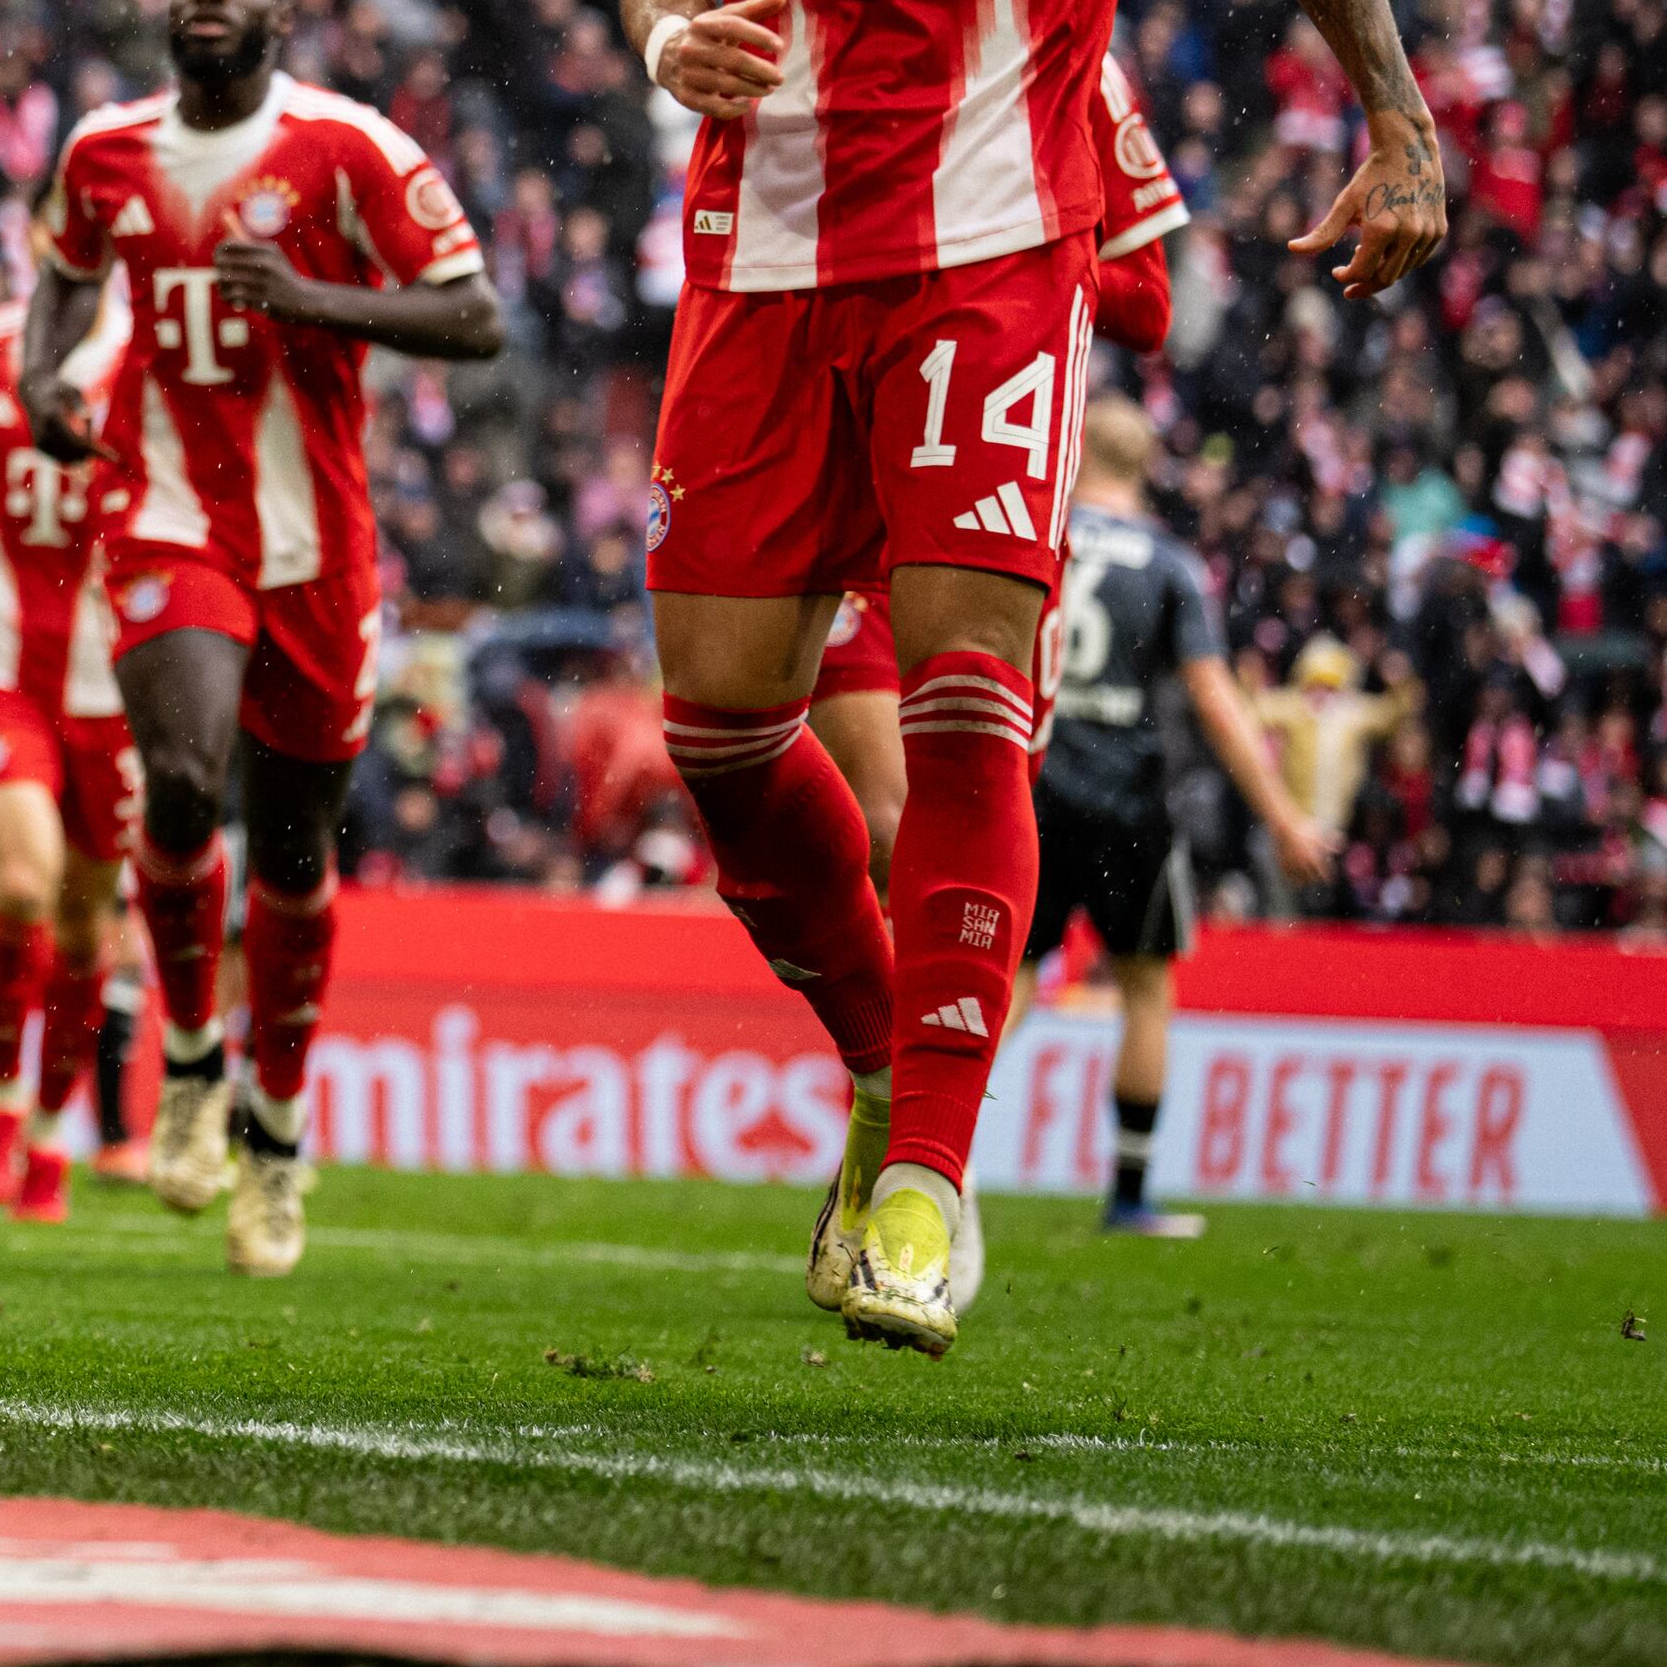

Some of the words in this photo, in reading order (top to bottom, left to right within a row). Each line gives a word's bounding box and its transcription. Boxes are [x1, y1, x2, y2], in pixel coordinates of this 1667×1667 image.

[910, 339, 1056, 481] 14
[959, 929, 993, 950] MIA
[962, 916, 996, 936] SAN
[964, 902, 1000, 923] MIA
[304, 1002, 851, 1187] mirates
[1193, 1054, 1528, 1204] BETTER
